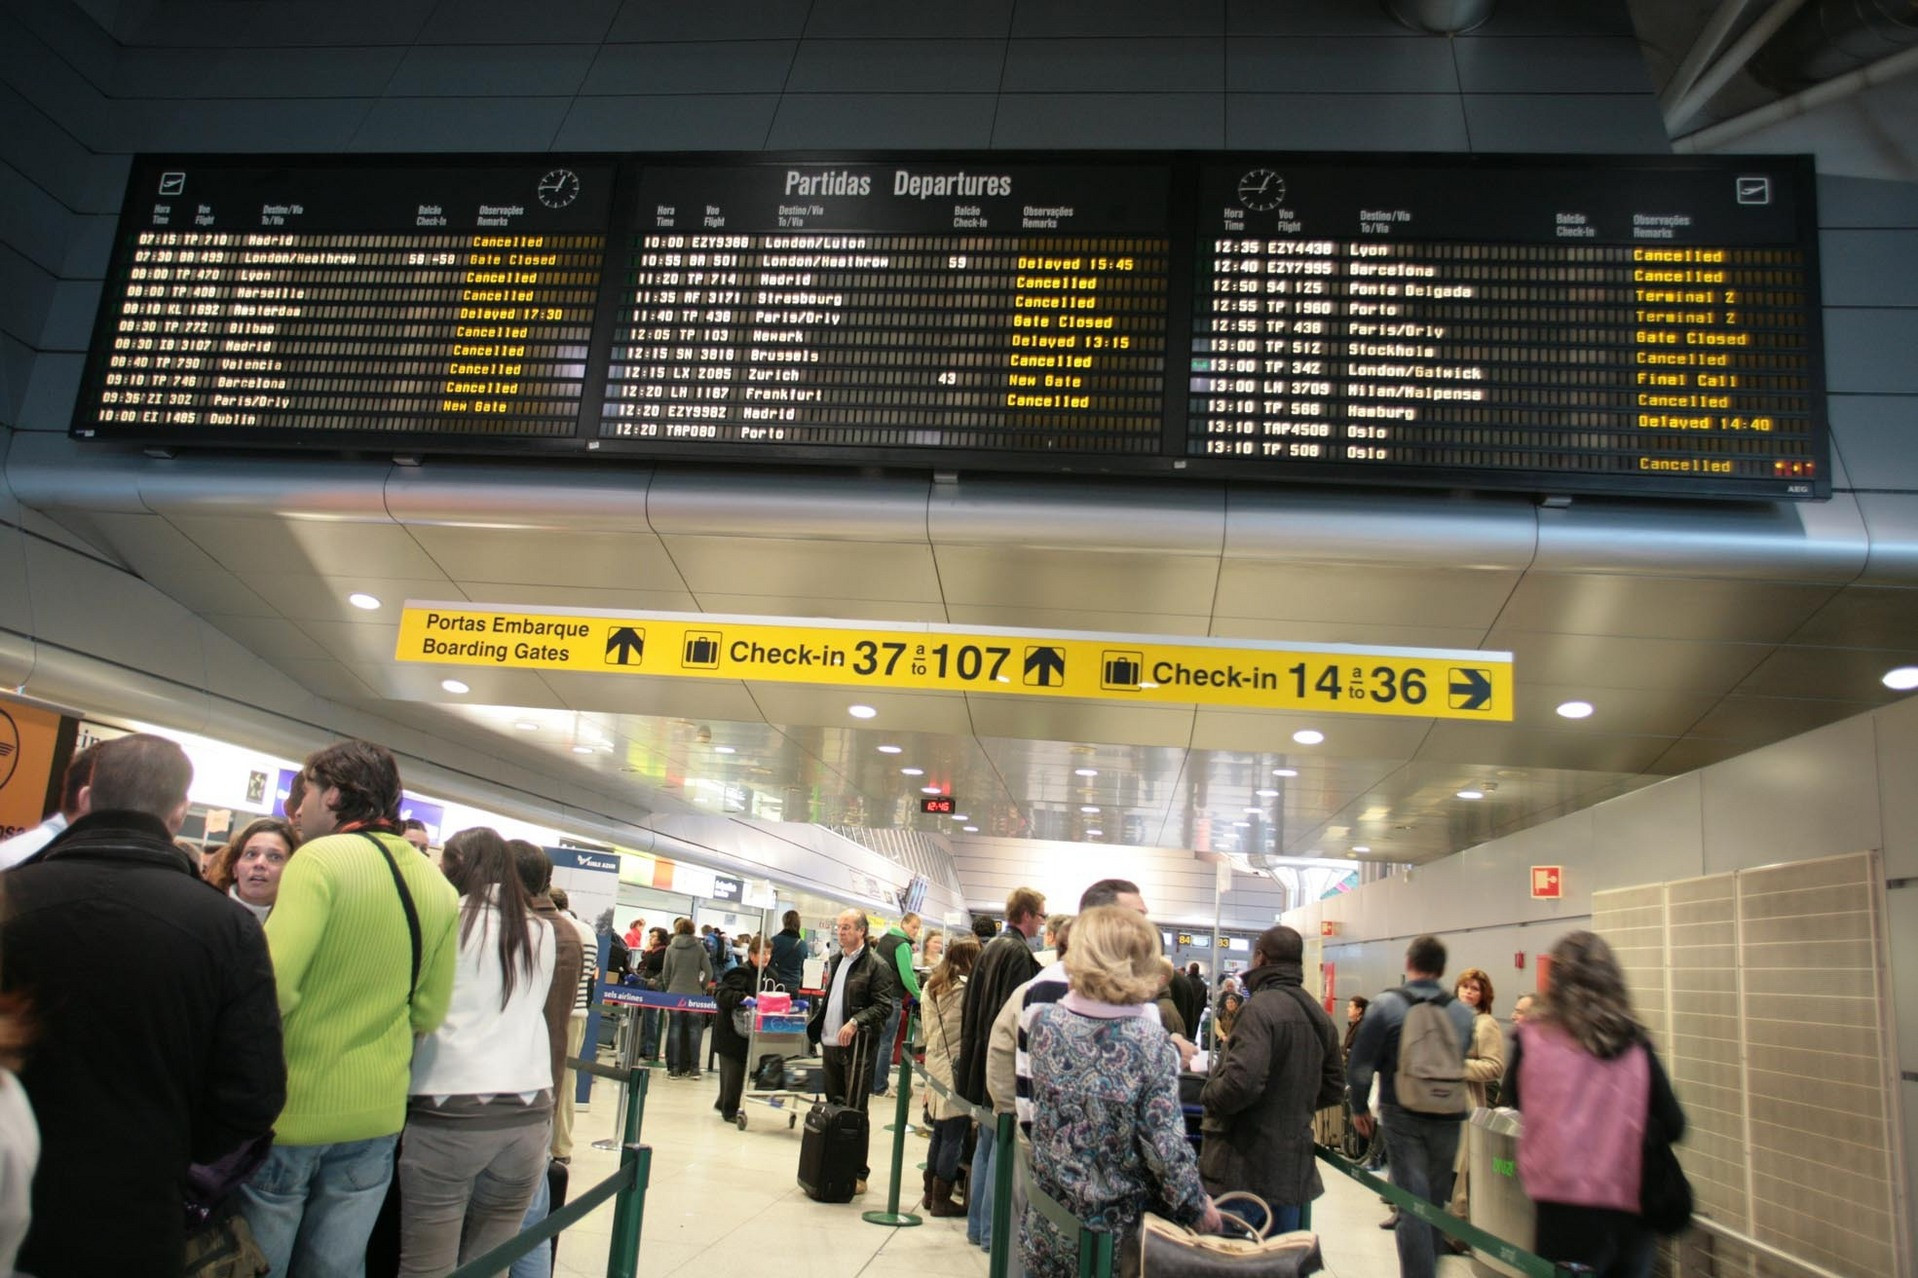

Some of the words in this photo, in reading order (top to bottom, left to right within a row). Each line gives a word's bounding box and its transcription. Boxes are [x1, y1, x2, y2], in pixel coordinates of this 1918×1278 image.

[785, 171, 871, 195] Partidas
[894, 171, 1011, 199] Departures
[657, 206, 675, 215] Hora
[706, 206, 719, 215] Voo
[1024, 206, 1073, 217] Observações
[657, 218, 674, 226] Time
[704, 217, 725, 227] Flight
[1023, 219, 1058, 228] Remarks
[1224, 221, 1244, 231] Time
[1278, 221, 1301, 232] Flight
[1634, 228, 1673, 238] Remarks
[140, 234, 176, 244] 07:15
[205, 235, 227, 245] 710
[249, 236, 293, 245] Madrid
[474, 237, 542, 246] Cancelled
[646, 237, 683, 247] 10:00
[766, 237, 865, 248] London/Luton
[136, 252, 172, 261] 07:30
[202, 252, 223, 262] 499
[245, 253, 356, 263] London/Heathrow
[471, 255, 500, 264] Gate
[510, 255, 555, 264] Closed
[1216, 241, 1258, 253] 12:35
[1351, 244, 1387, 256] Lyon
[1634, 250, 1723, 262] Cancelled
[643, 255, 681, 266] 10:55
[714, 255, 736, 266] 501
[763, 256, 888, 267] London/Heathrow
[949, 257, 966, 268] 59
[1019, 258, 1080, 270] Delayed
[1091, 259, 1132, 270] 15:45
[198, 270, 219, 279] 470
[241, 271, 270, 281] Lyon
[467, 273, 536, 283] Cancelled
[1215, 261, 1258, 272] 12:40
[1350, 263, 1433, 276] Barcelona
[1635, 270, 1723, 282] Cancelled
[640, 273, 678, 284] 11:20
[712, 274, 736, 284] 714
[761, 274, 810, 285] Madrid
[1017, 277, 1096, 289] Cancelled
[238, 288, 304, 298] Marseille
[464, 291, 533, 301] Cancelled
[637, 292, 675, 302] 11:35
[709, 292, 739, 303] 3171
[759, 293, 842, 306] Strasbourg
[1016, 296, 1095, 308] Cancelled
[1215, 280, 1257, 292] 12:50
[1297, 282, 1322, 293] 125
[1350, 283, 1396, 295] Ponta
[1406, 285, 1471, 298] Delgada
[1636, 291, 1713, 303] Terminal
[234, 305, 300, 316] Amsterdam
[461, 308, 515, 319] Delayed
[525, 309, 562, 319] 17:30
[634, 311, 673, 321] 11:40
[756, 312, 839, 324] Paris/Orly
[1014, 315, 1049, 327] Gate
[1059, 316, 1112, 328] Closed
[1214, 300, 1257, 311] 12:55
[1350, 303, 1396, 315] Porto
[1636, 311, 1713, 323] Terminal
[186, 322, 207, 332] 772
[230, 323, 274, 333] Bilbao
[457, 327, 527, 337] Cancelled
[1213, 320, 1256, 331] 12:55
[1350, 324, 1443, 338] Paris/Orly
[1637, 332, 1676, 343] Gate
[1687, 333, 1746, 344] Closed
[632, 329, 670, 339] 12:05
[705, 330, 728, 340] 103
[754, 331, 802, 341] Newark
[1013, 335, 1075, 347] Delayed
[1086, 337, 1128, 348] 13:15
[182, 340, 211, 350] 3107
[226, 341, 271, 351] Madrid
[454, 345, 524, 356] Cancelled
[1212, 340, 1255, 351] 13:00
[1293, 342, 1320, 353] 512
[1349, 344, 1433, 357] Stockholm
[1638, 353, 1726, 365] Cancelled
[178, 358, 199, 368] 790
[222, 360, 281, 369] Valencia
[450, 364, 521, 374] Cancelled
[629, 348, 667, 359] 12:15
[751, 349, 818, 361] Brussels
[1011, 355, 1091, 367] Cancelled
[626, 367, 664, 378] 12:15
[749, 369, 799, 380] Zurich
[939, 373, 955, 384] 43
[1010, 375, 1035, 385] New
[1045, 375, 1081, 387] Gate
[1211, 359, 1255, 372] 13:00
[1293, 362, 1320, 374] 342
[1349, 364, 1481, 379] London/Gatwick
[1638, 373, 1684, 385] Final
[1698, 375, 1735, 386] Call
[107, 375, 144, 385] 09:10
[218, 377, 285, 388] Barcelona
[447, 382, 517, 393] Cancelled
[103, 392, 139, 403] 09:35
[170, 394, 191, 404] 302
[214, 395, 289, 408] Paris/Orly
[444, 401, 466, 410] New
[475, 402, 506, 412] Gate
[623, 386, 662, 397] 12:20
[746, 388, 821, 400] Frankfurt
[1008, 394, 1088, 407] Cancelled
[1210, 380, 1254, 392] 13:00
[1292, 383, 1329, 394] 3709
[1349, 385, 1482, 400] Milan/Malpensa
[1639, 395, 1728, 407] Cancelled
[100, 411, 135, 421] 10:00
[210, 414, 255, 424] Dublin
[620, 405, 659, 416] 12:20
[744, 408, 794, 419] Madrid
[1210, 400, 1254, 412] 13:10
[1348, 406, 1414, 420] Hamburg
[1639, 415, 1710, 428] Delayed
[1722, 419, 1770, 430] 14:40
[617, 424, 656, 435] 12:20
[742, 427, 783, 439] Porto
[1209, 421, 1253, 433] 13:10
[1348, 426, 1386, 438] Oslo
[1208, 441, 1252, 453] 13:10
[1348, 447, 1385, 459] Oslo
[1641, 459, 1730, 471] Cancelled
[426, 614, 486, 632] Portas
[492, 617, 590, 639] Embarque
[422, 638, 507, 663] Boarding
[513, 642, 570, 662] Gates
[730, 640, 845, 668] Check-in
[853, 641, 907, 676] 37
[916, 646, 924, 655] a
[932, 641, 1011, 681] 107
[911, 661, 926, 676] to
[1153, 662, 1277, 690] Check-in
[1289, 663, 1341, 700] 14
[1352, 668, 1362, 678] a
[1370, 667, 1427, 704] 36
[1349, 685, 1364, 699] to
[1179, 935, 1190, 944] 84
[618, 994, 643, 1002] airlines
[688, 999, 716, 1009] brussels
